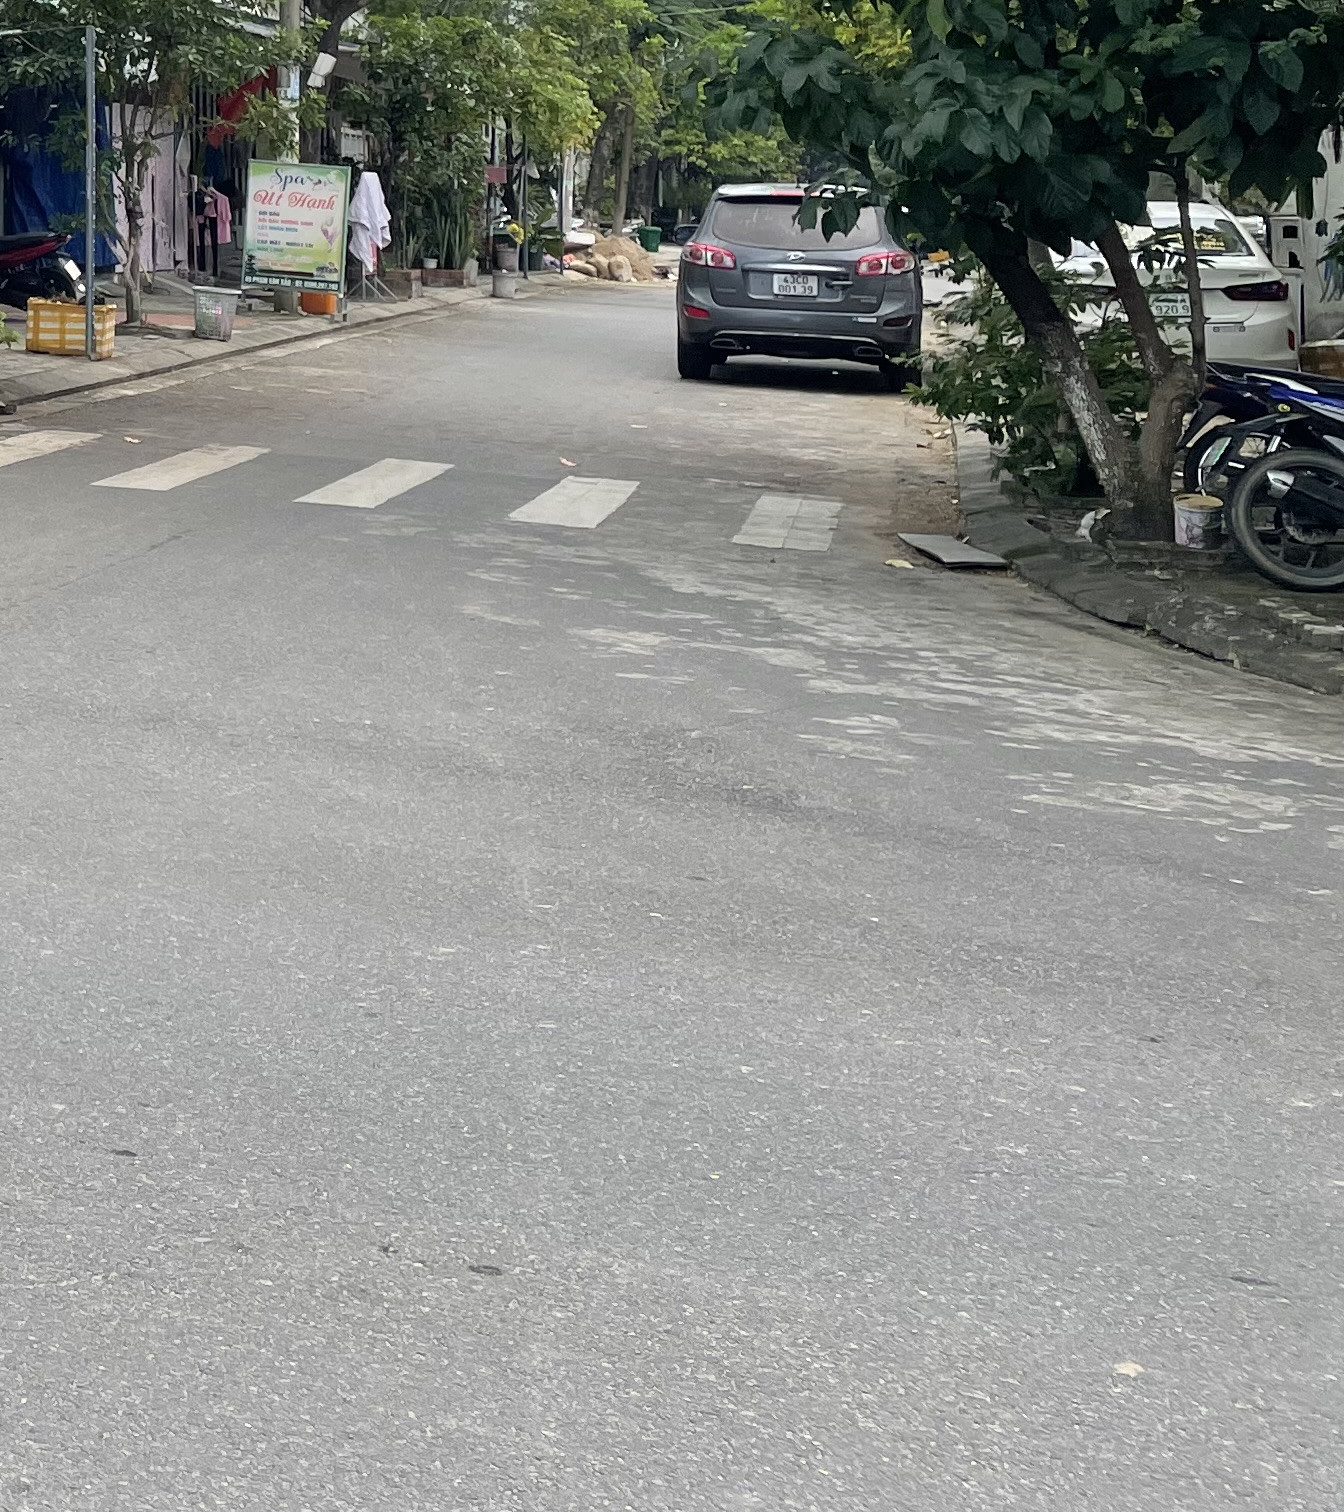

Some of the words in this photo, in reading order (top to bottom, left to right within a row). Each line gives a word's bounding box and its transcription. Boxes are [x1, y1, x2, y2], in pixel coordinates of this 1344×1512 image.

[269, 167, 305, 191] Spa
[288, 191, 338, 210] Hạnh
[1155, 304, 1190, 315] 920.9
